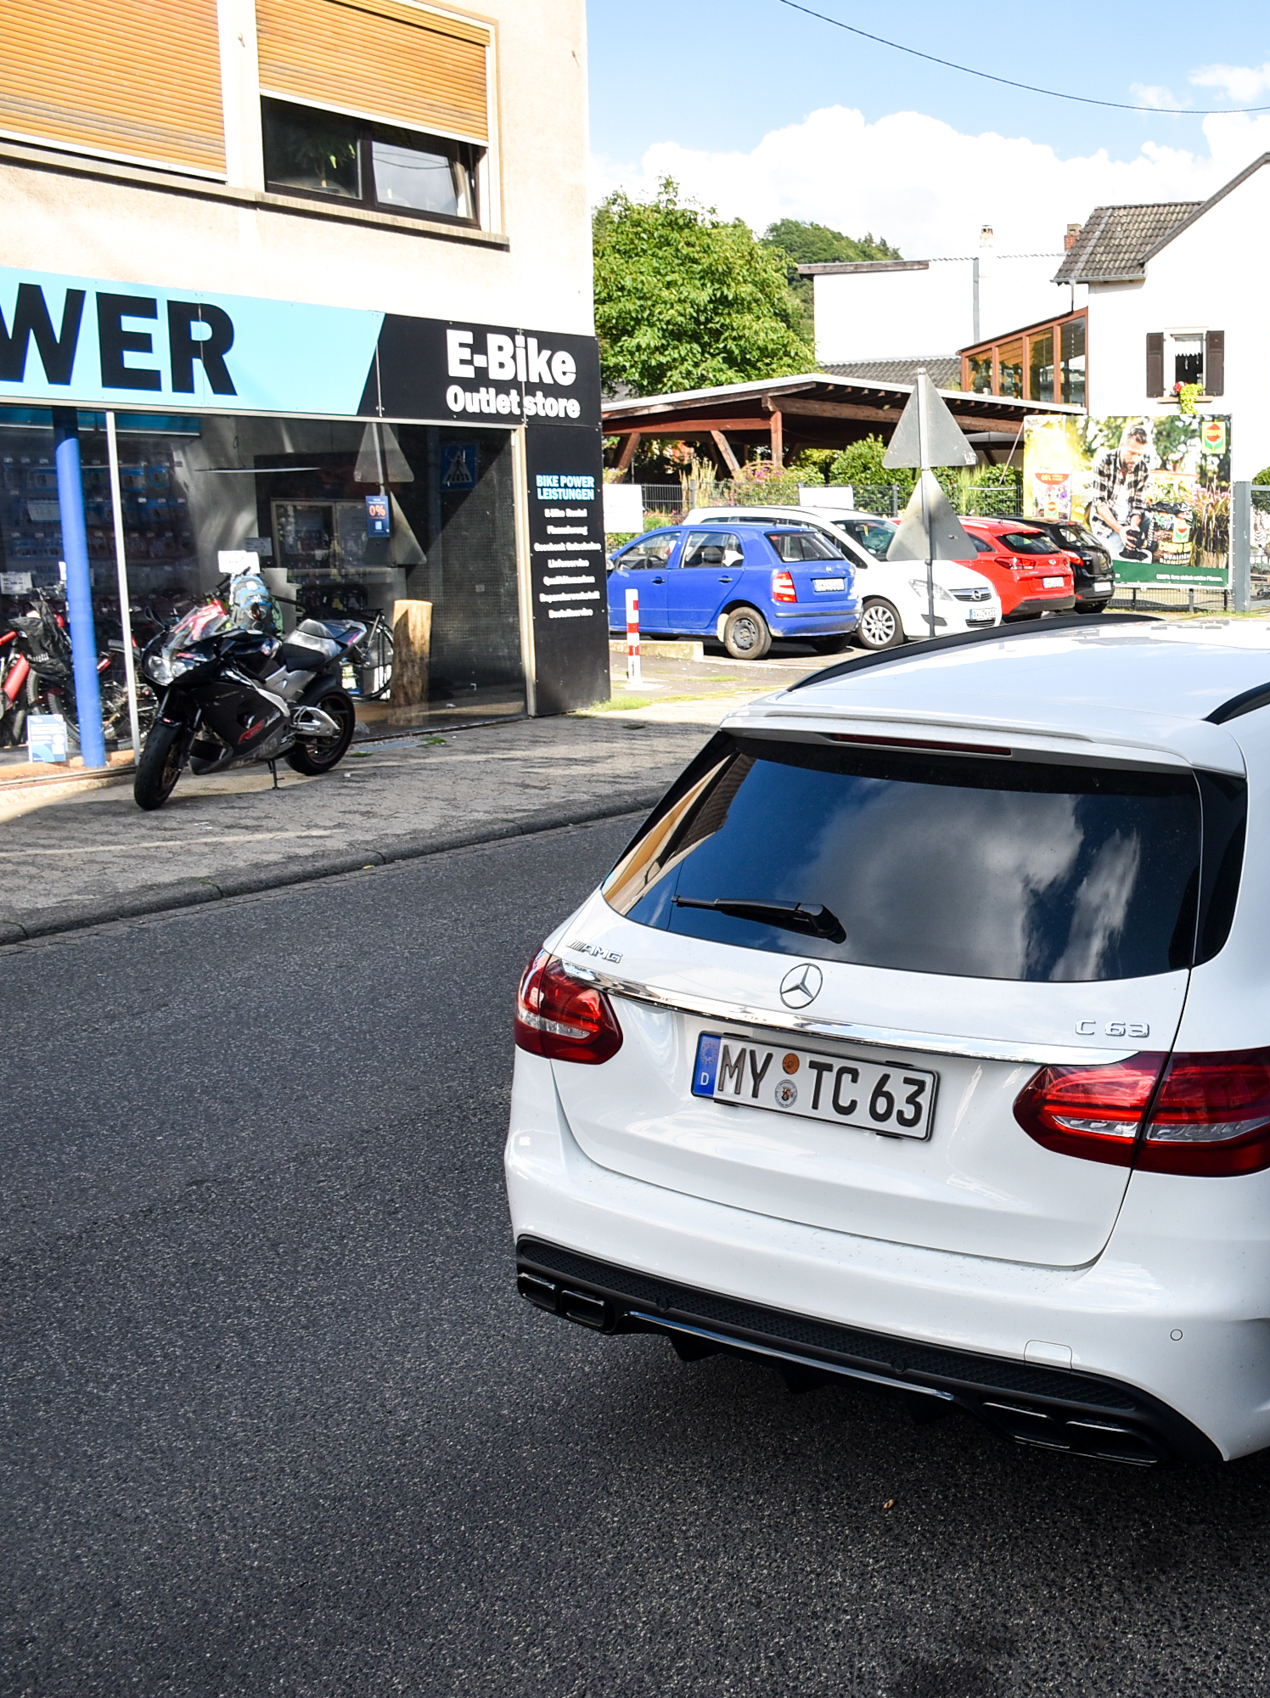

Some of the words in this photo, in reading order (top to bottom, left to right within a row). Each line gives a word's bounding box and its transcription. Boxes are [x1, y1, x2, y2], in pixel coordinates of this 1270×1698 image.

[446, 329, 577, 386] E-Bike
[446, 384, 521, 415] Outlet
[523, 391, 581, 419] store
[536, 474, 560, 488] BIKE
[560, 475, 595, 488] POWER
[537, 488, 595, 500] LEISTUNGEN
[1075, 1019, 1096, 1035] C
[1104, 1020, 1150, 1038] 63
[700, 1072, 709, 1086] D
[717, 1044, 773, 1098] MY
[808, 1060, 860, 1116] TC
[869, 1073, 927, 1128] 63
